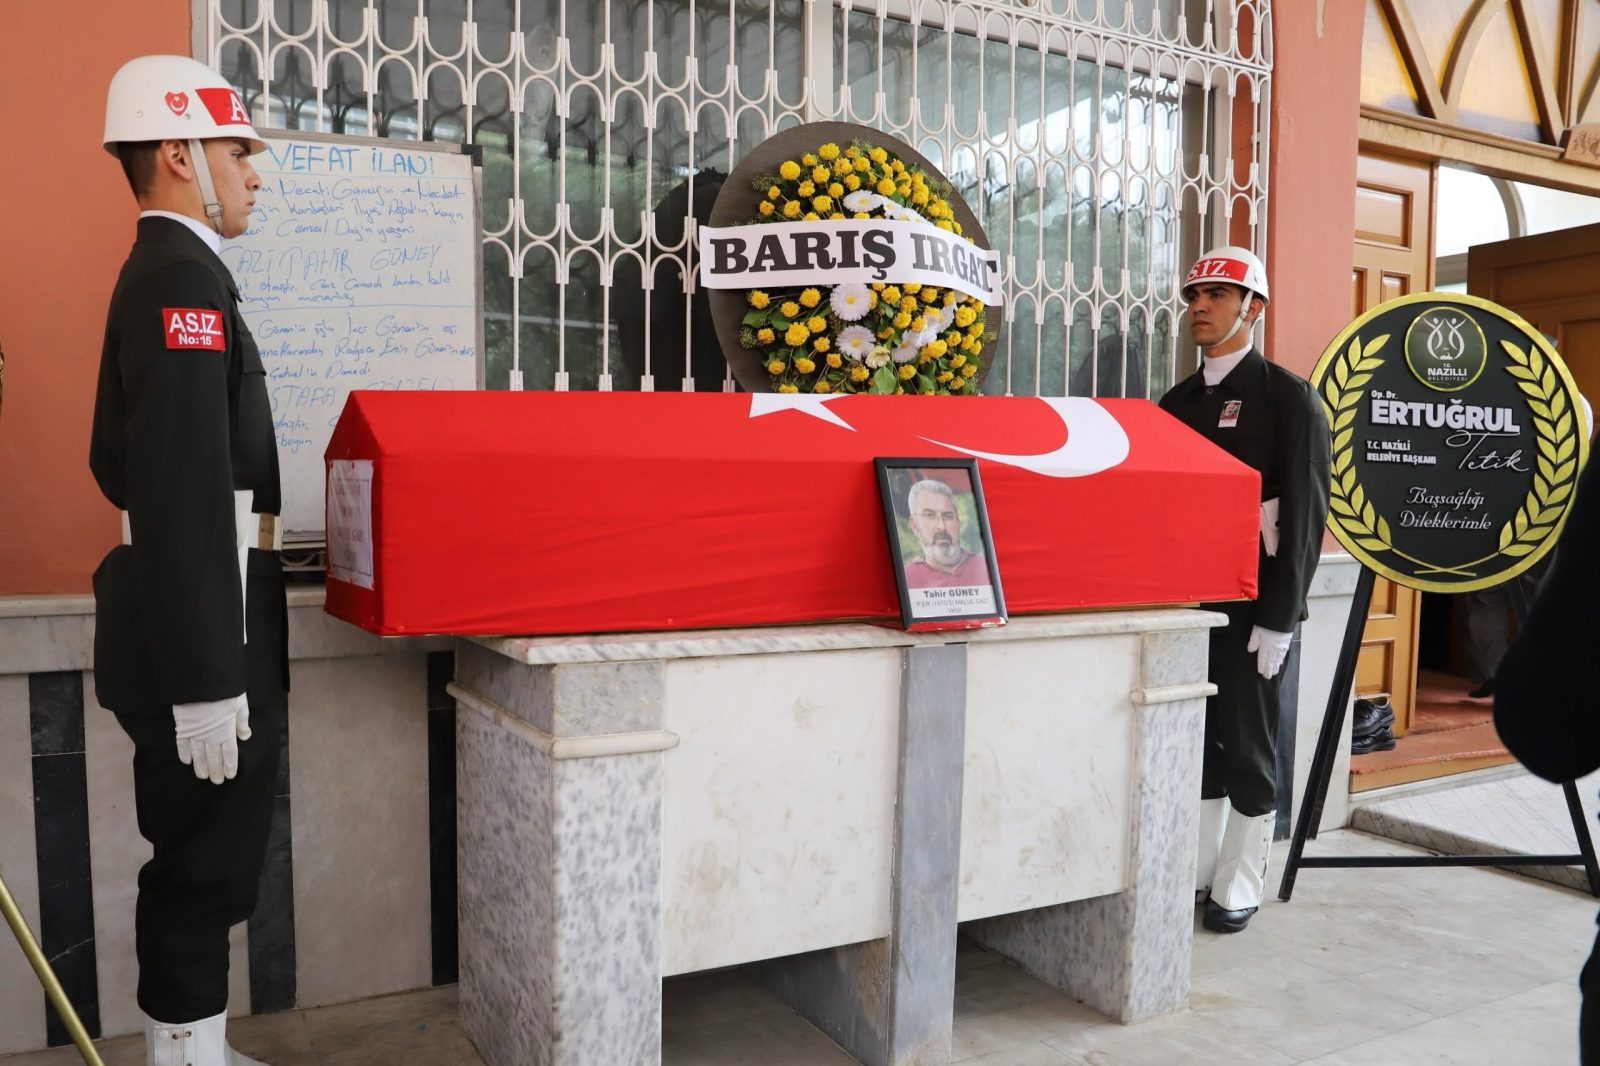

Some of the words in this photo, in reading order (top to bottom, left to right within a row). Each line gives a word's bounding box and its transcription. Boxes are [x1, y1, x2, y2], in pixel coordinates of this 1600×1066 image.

[267, 143, 360, 173] VEFAT
[220, 246, 274, 273] AZİ
[370, 244, 442, 270] GÜNEY
[709, 229, 897, 281] BARIŞ
[910, 233, 998, 293] IRGAT
[1371, 389, 1385, 400] Op.
[1386, 390, 1398, 400] Dr.
[1371, 398, 1521, 433] ERTUĞRUL
[1366, 440, 1381, 450] T.C.
[1381, 440, 1411, 451] NAZİLLİ
[1445, 430, 1530, 472] Tetik
[1366, 451, 1401, 463] BELEDİYE
[1402, 454, 1437, 466] BAŞKANI
[1406, 486, 1485, 511] Başsağlığı
[1400, 509, 1492, 530] Dileklerimle
[923, 590, 947, 599] Tahir
[949, 587, 980, 598] GÜNEY
